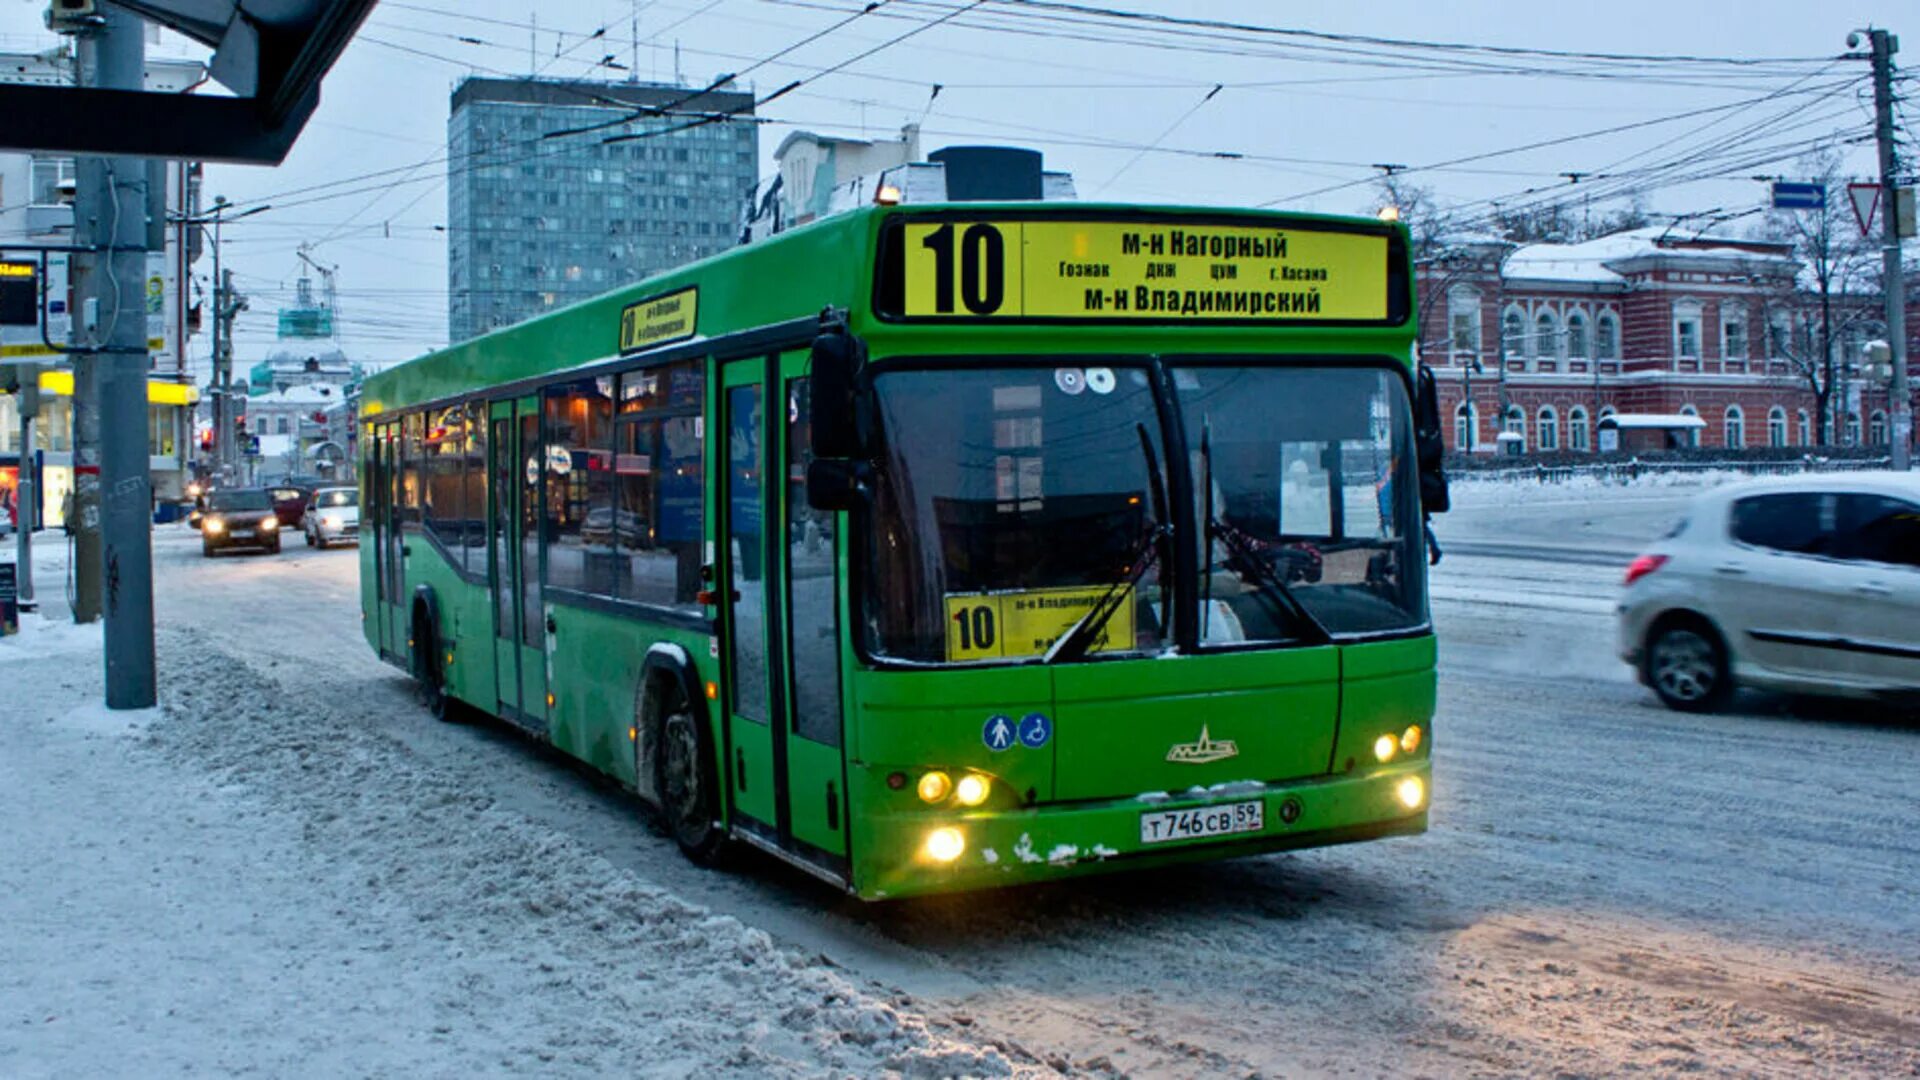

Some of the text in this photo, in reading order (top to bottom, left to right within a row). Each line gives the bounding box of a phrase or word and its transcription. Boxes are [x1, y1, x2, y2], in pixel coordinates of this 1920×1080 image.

[1122, 231, 1287, 259] м-н Нагорный
[923, 223, 1004, 315] 10
[1059, 261, 1109, 278] Гознак
[1210, 264, 1237, 282] ЦУМ
[1281, 266, 1327, 281] Хасана
[1085, 286, 1320, 315] м-н Владимирский
[953, 606, 995, 650] 10
[1236, 804, 1256, 822] 59
